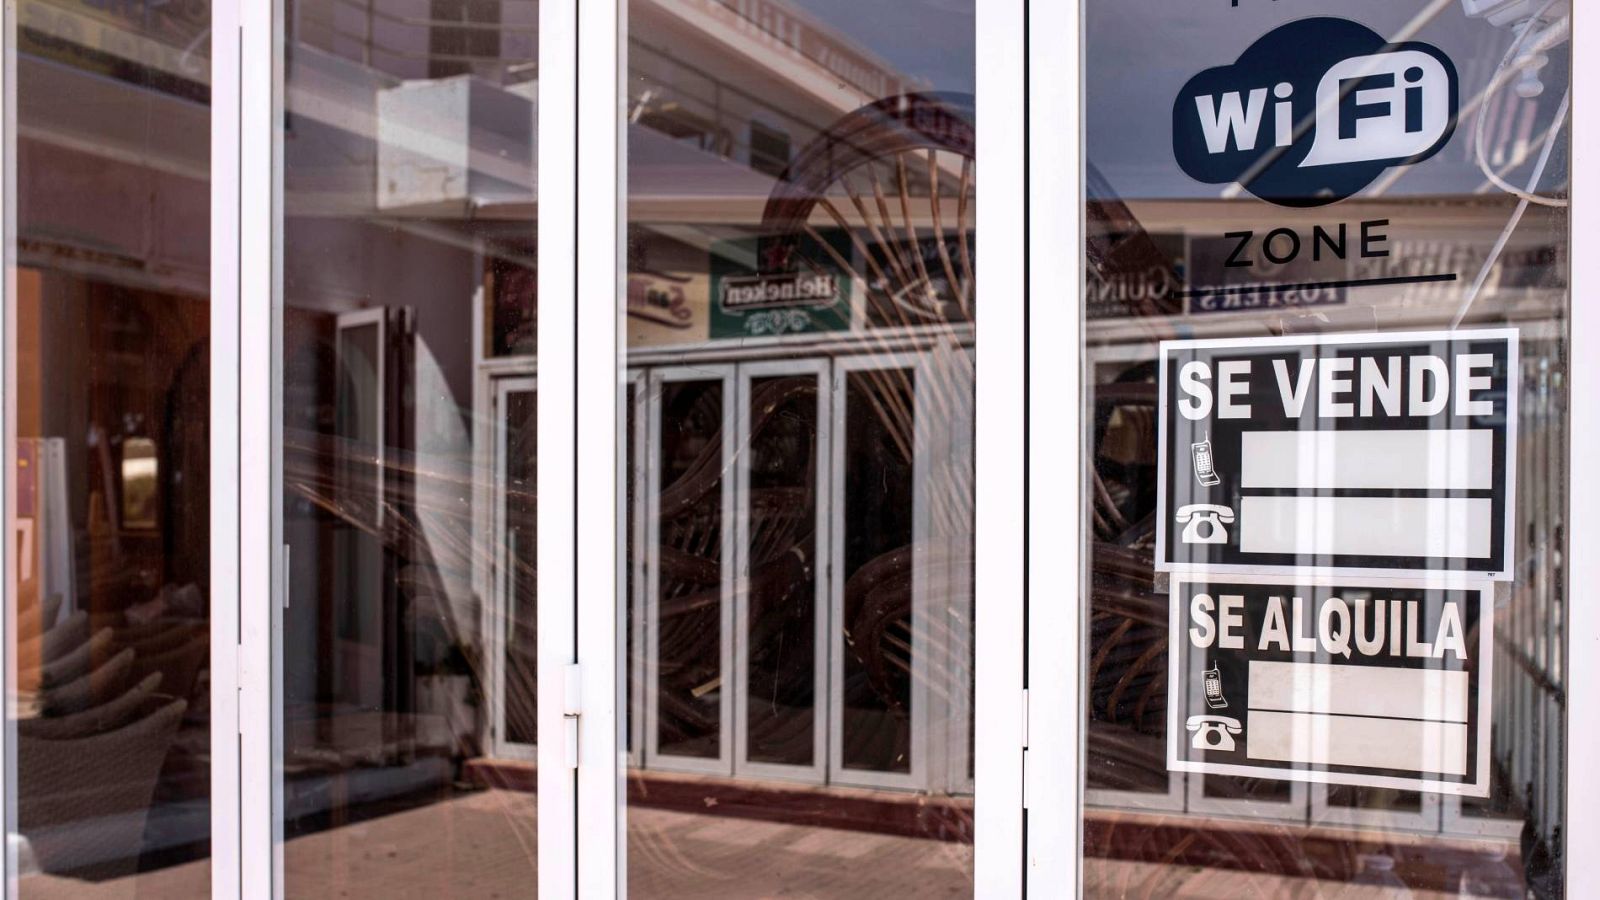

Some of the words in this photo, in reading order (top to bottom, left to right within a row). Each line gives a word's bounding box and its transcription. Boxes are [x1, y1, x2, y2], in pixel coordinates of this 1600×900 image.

[1224, 219, 1390, 268] ZONE
[1177, 360, 1252, 421] SE
[1272, 353, 1494, 418] VENDE
[1189, 593, 1245, 650] SE
[1258, 596, 1468, 660] ALQUILA
